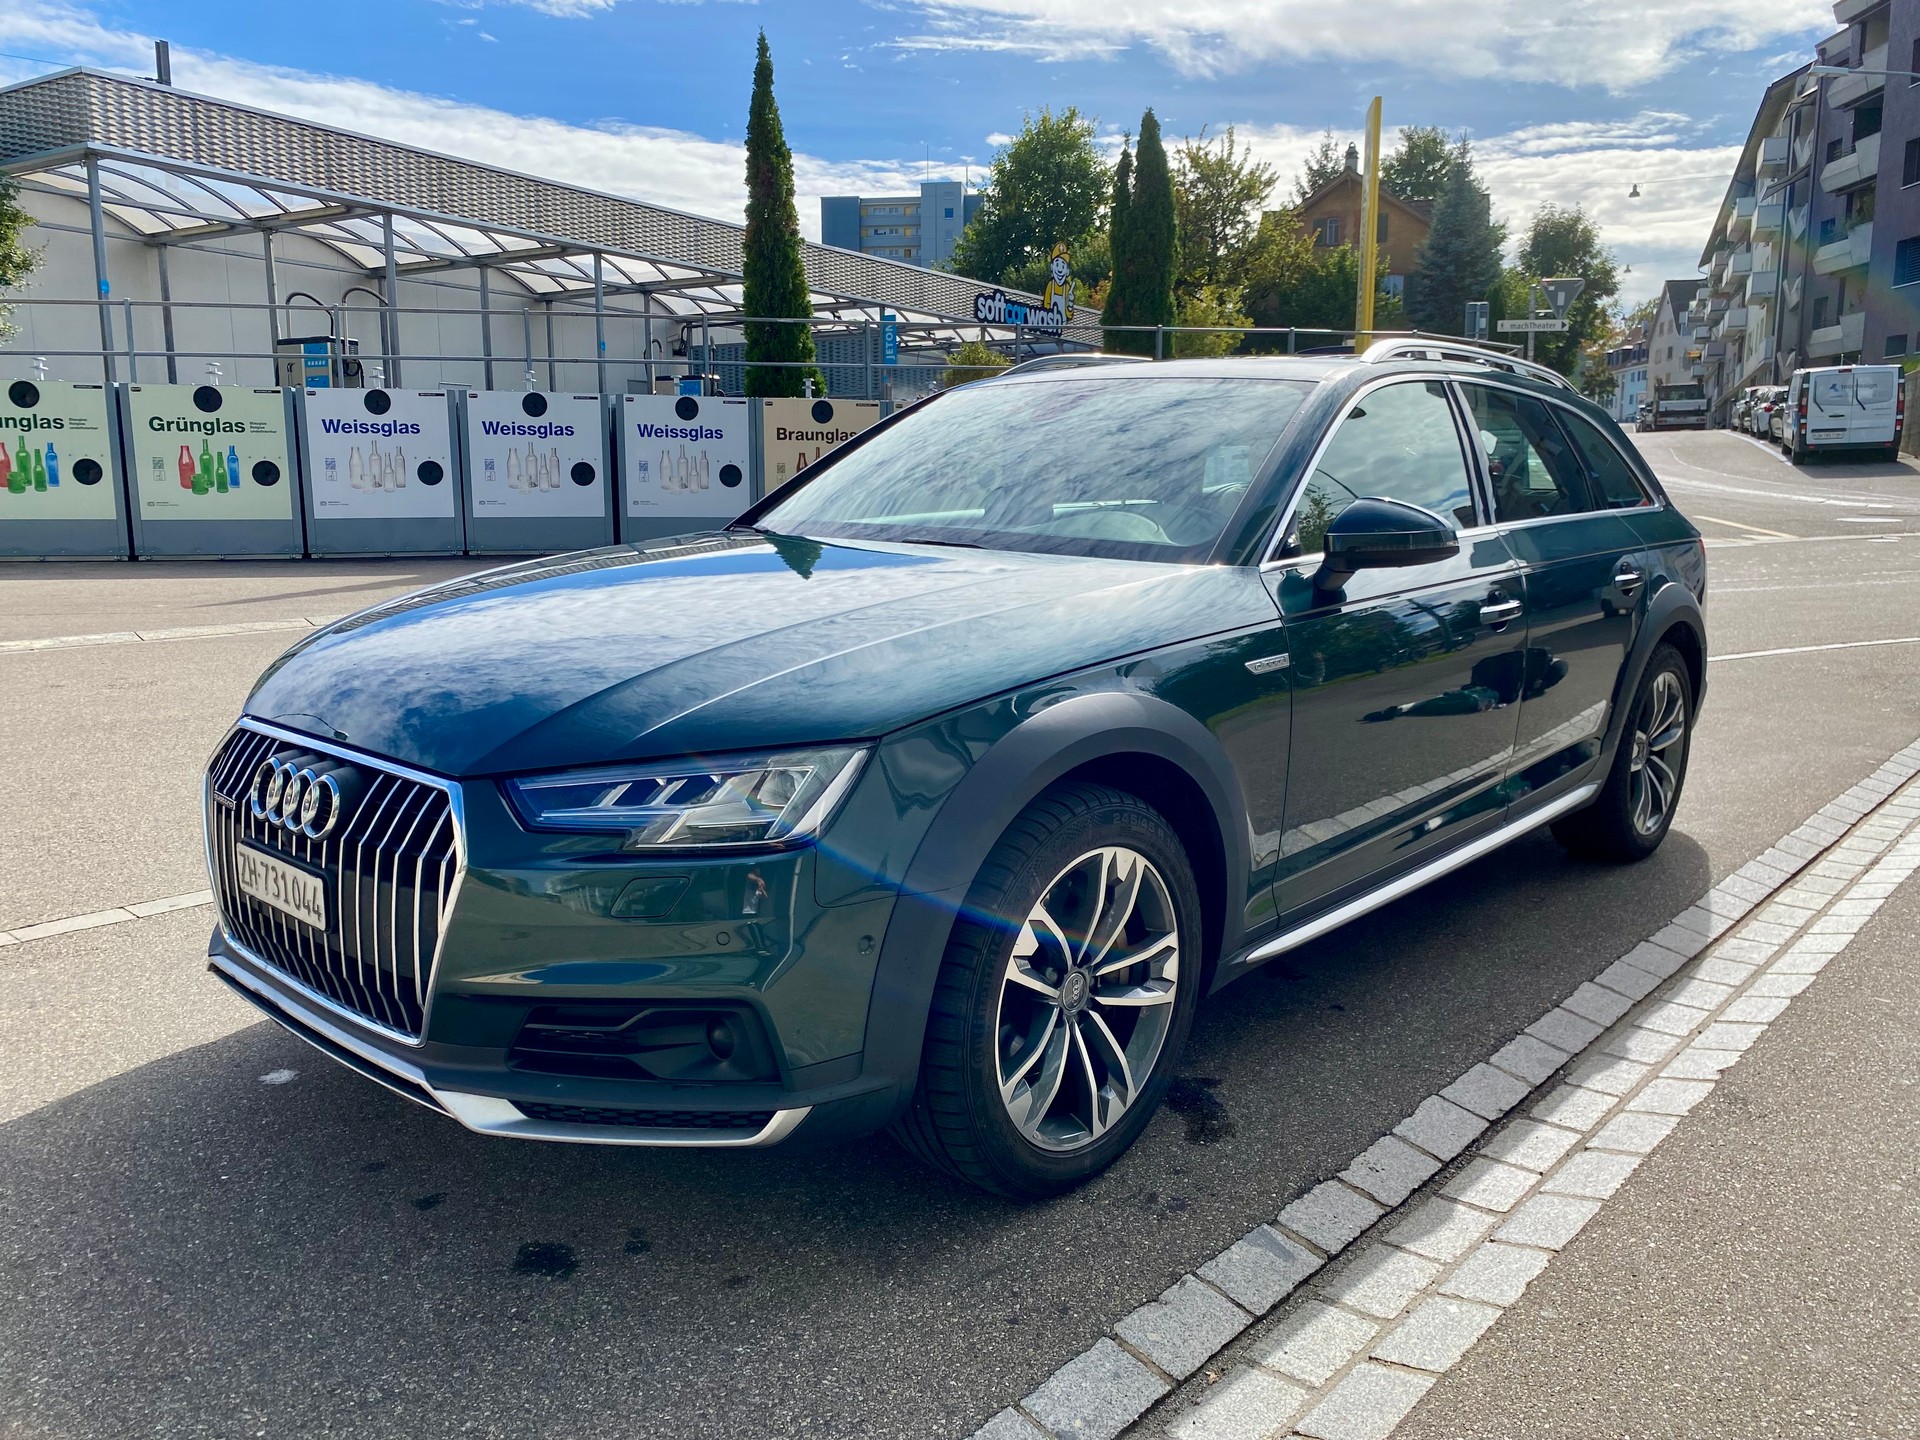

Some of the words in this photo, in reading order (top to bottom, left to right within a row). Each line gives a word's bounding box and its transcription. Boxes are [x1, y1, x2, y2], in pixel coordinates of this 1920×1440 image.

[148, 416, 246, 436] Grünglas
[321, 418, 421, 438] Weissglas
[481, 420, 575, 441] Weissglas
[637, 423, 724, 442] Weissglas
